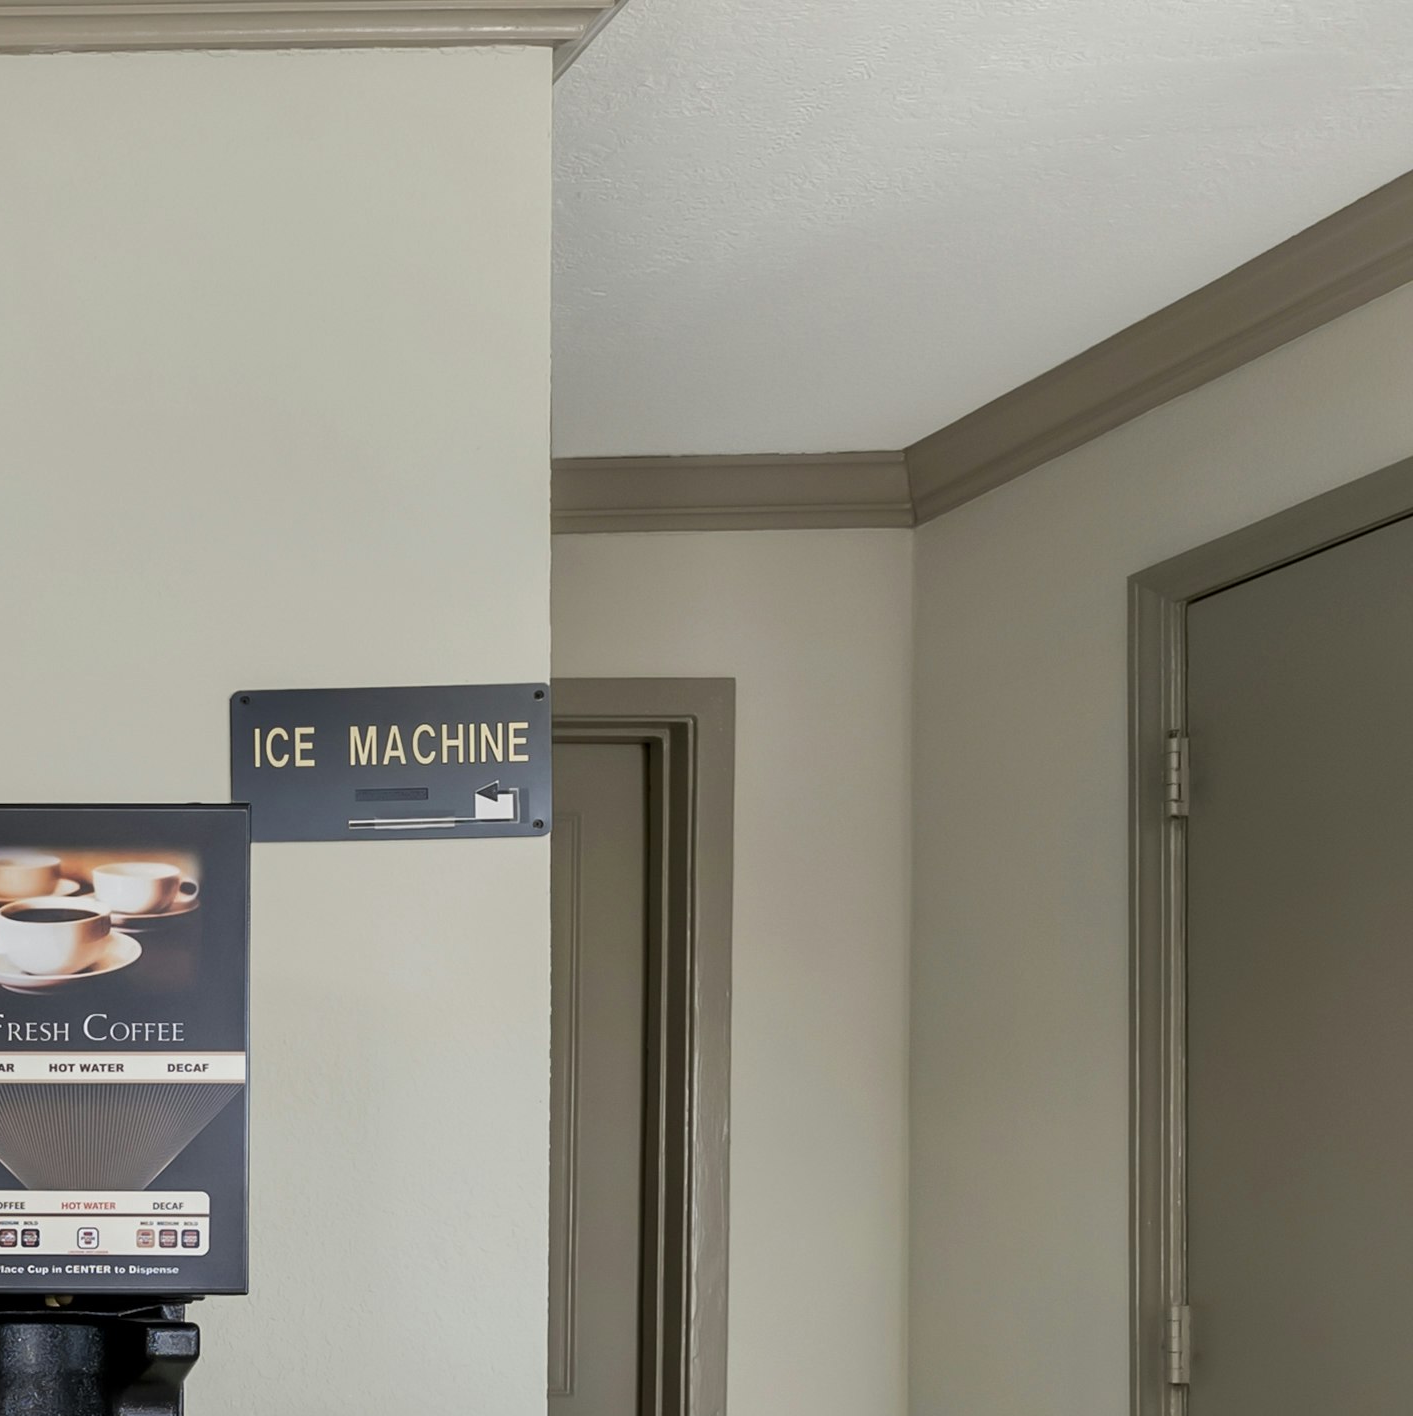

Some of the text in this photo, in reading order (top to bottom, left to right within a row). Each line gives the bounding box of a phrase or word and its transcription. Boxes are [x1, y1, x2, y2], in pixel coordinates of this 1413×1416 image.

[254, 721, 529, 768] ICE MACHINE
[82, 1013, 185, 1042] COFFEE
[48, 1063, 124, 1073] HOT WATER
[167, 1063, 210, 1073] DECAF
[61, 1202, 116, 1210] HOT WATER
[152, 1202, 185, 1210] DECAF
[27, 1264, 49, 1276] Cup
[51, 1264, 62, 1274] in
[65, 1264, 111, 1274] CENTER
[114, 1265, 125, 1274] to
[128, 1264, 179, 1276] Dispense
